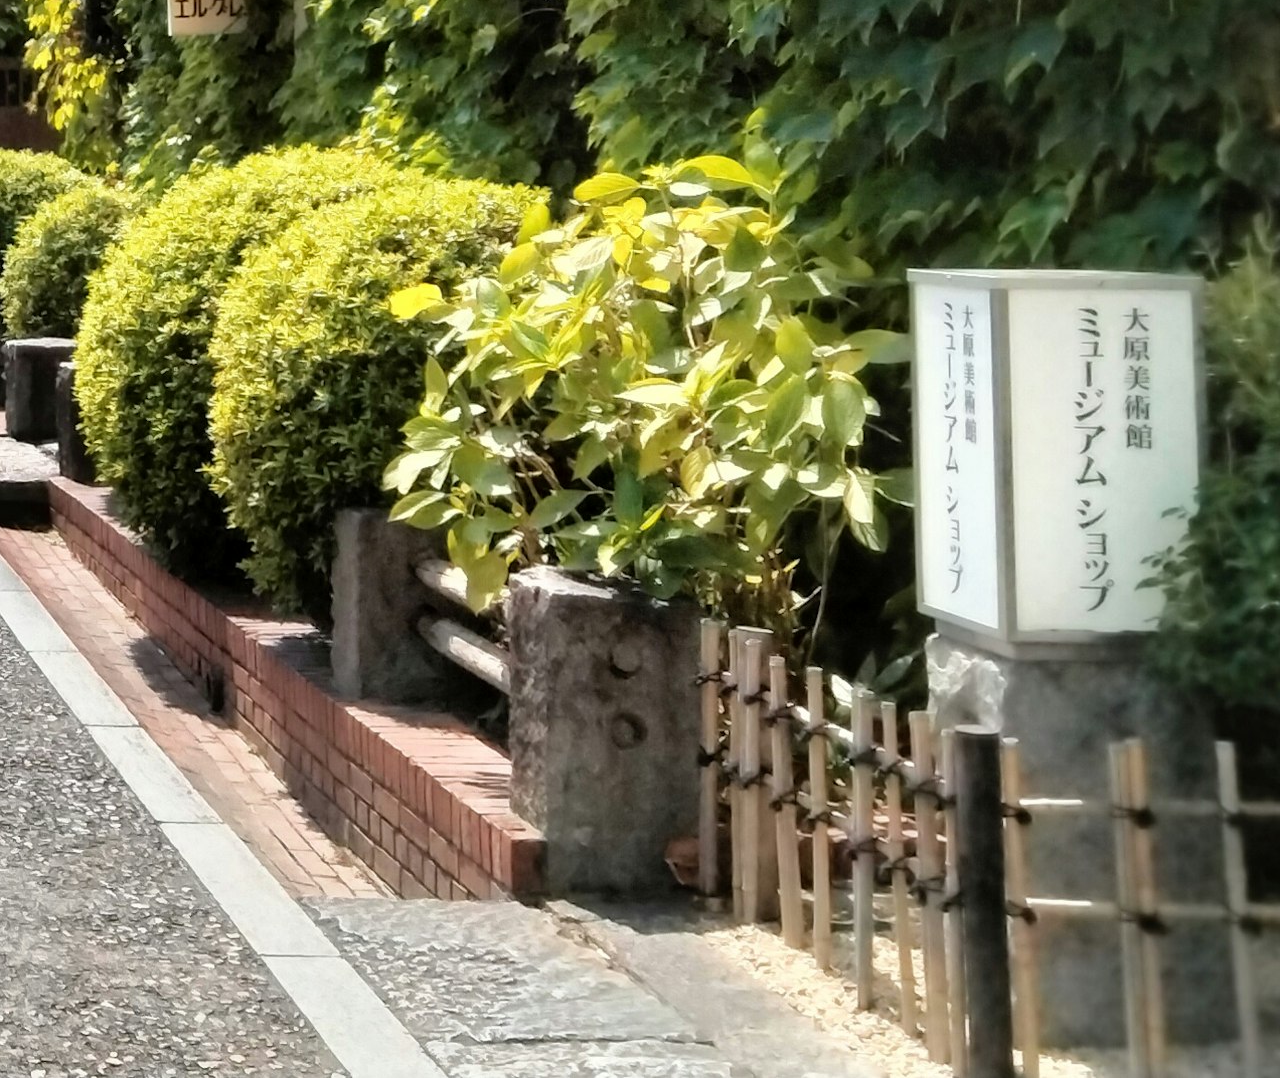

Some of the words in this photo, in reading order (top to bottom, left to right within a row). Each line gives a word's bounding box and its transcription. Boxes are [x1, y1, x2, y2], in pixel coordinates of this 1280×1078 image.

[943, 301, 959, 474] ミュージアム
[962, 304, 977, 444] 大原美術館
[1073, 308, 1107, 486] ミュージアム
[1122, 307, 1152, 450] 大原美術館
[946, 485, 963, 594] ショップ
[1076, 499, 1115, 612] ショップ
